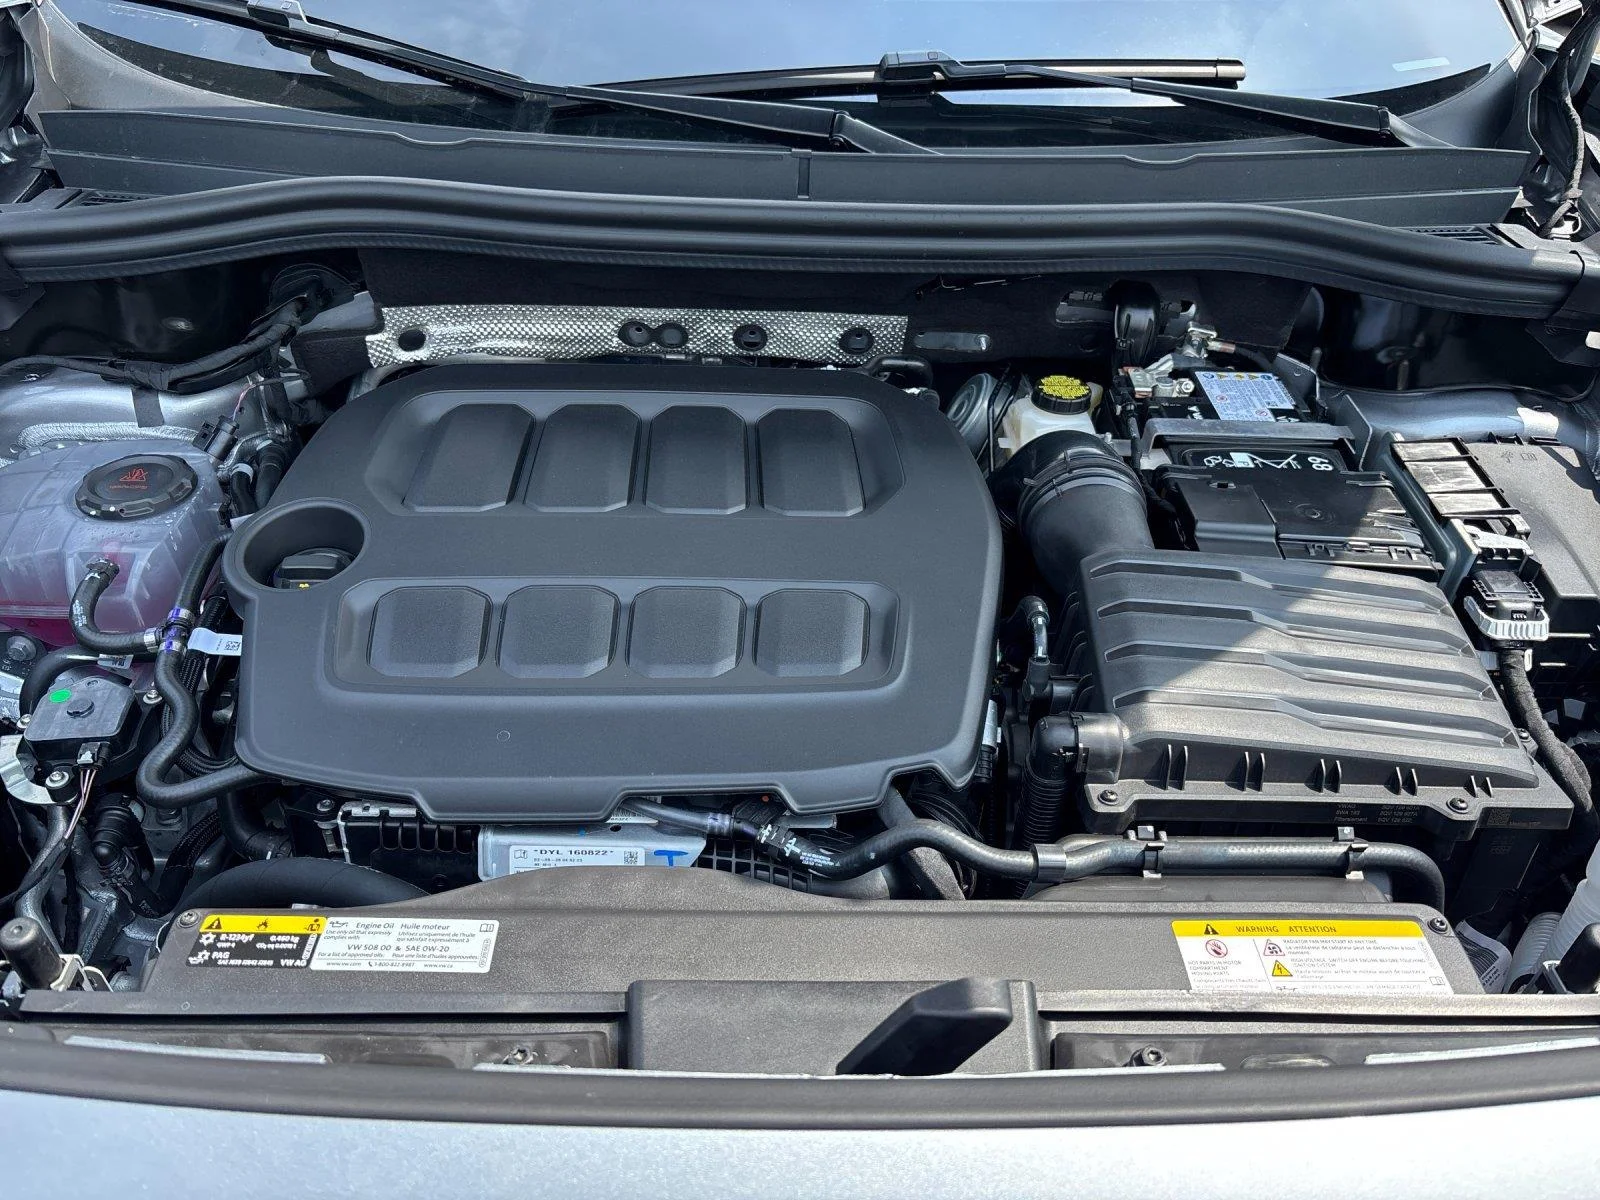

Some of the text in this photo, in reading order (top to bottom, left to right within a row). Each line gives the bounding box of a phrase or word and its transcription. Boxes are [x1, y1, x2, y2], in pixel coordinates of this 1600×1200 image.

[355, 922, 395, 931] Engine Oil
[400, 922, 451, 931] Huile moteur
[1235, 925, 1279, 933] WARNING
[1288, 925, 1337, 933] ATTENTION
[211, 951, 230, 960] PAG
[280, 958, 307, 967] VW AG
